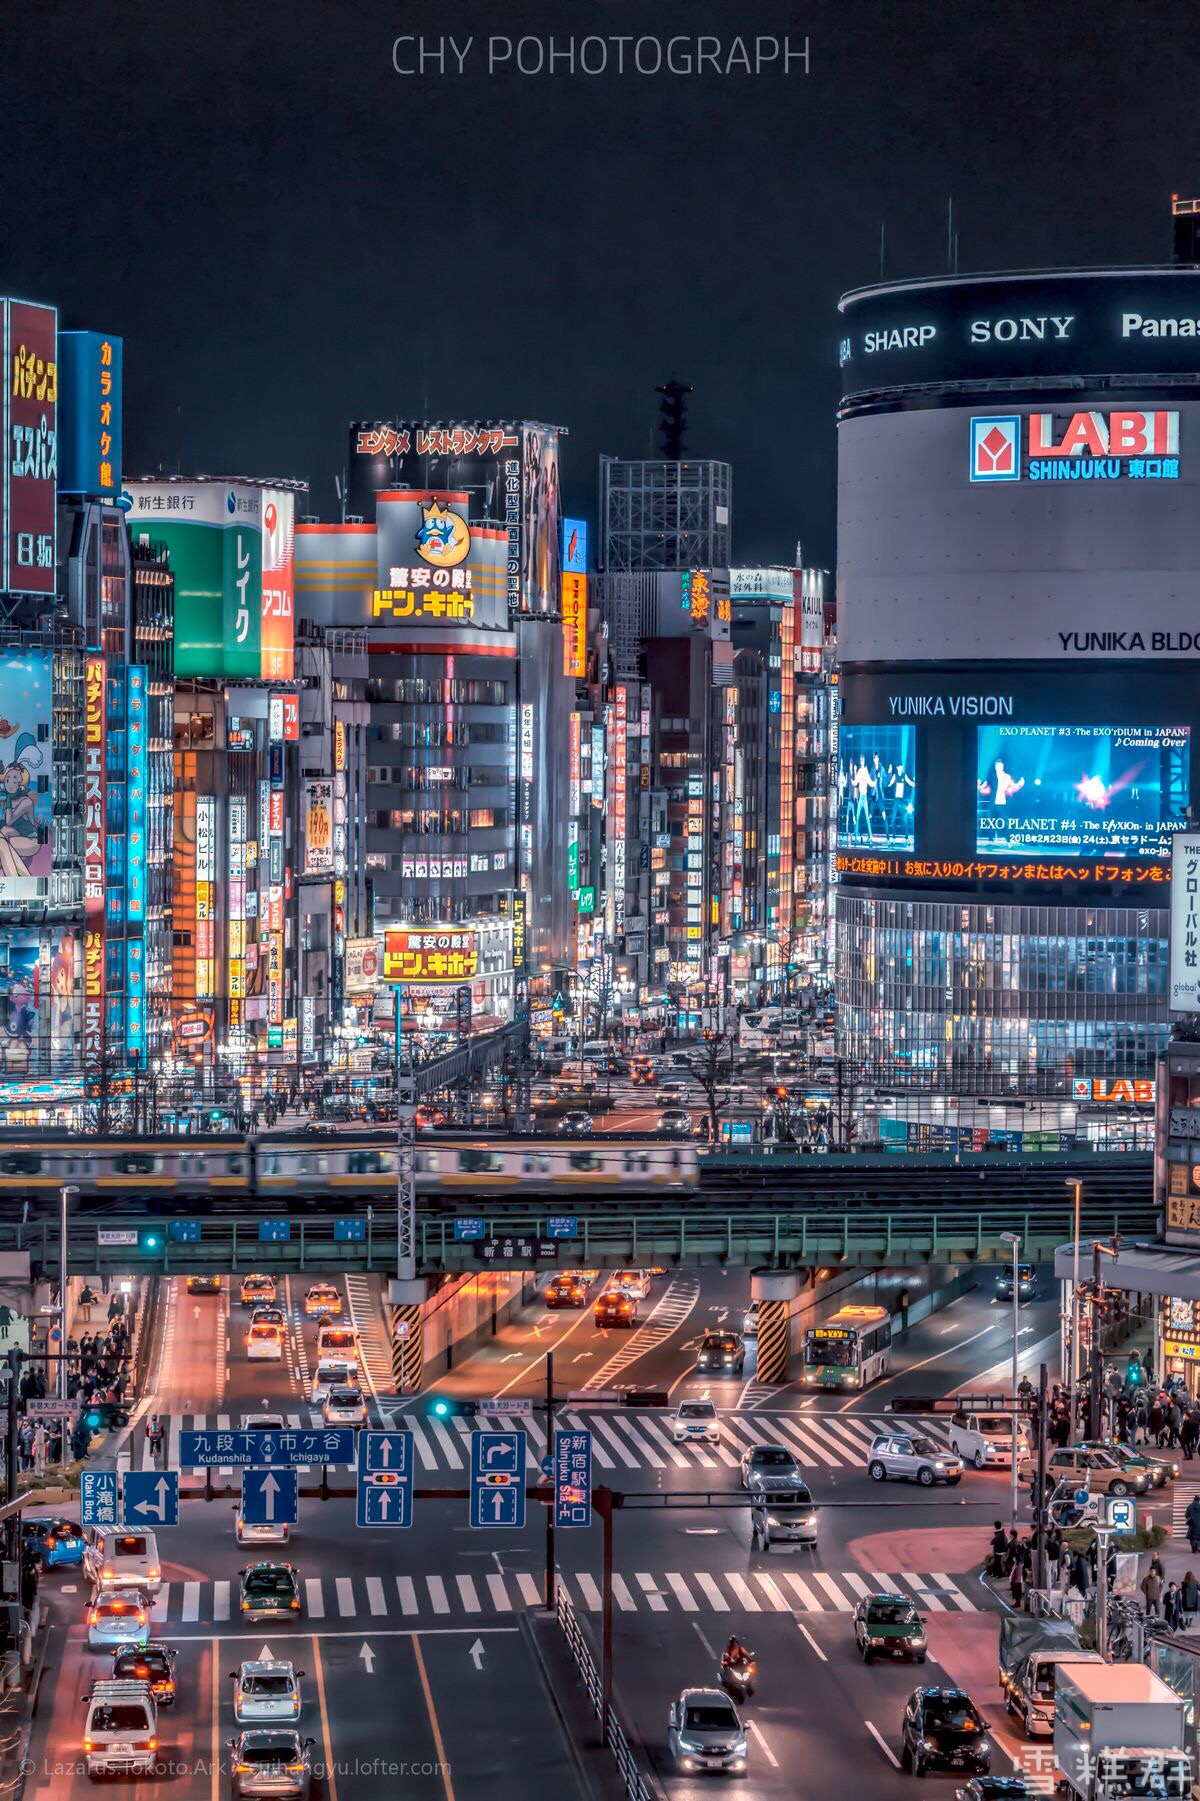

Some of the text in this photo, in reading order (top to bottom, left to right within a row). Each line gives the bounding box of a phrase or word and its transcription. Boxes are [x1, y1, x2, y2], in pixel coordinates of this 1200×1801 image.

[864, 325, 936, 353] SHARP
[970, 316, 1075, 343] SONY
[13, 344, 57, 402] パチンコ
[100, 341, 113, 487] カラオケ館
[12, 413, 57, 480] エスパス
[357, 429, 518, 456] エンタメ レストランタワー
[1028, 410, 1180, 457] LABI
[1029, 459, 1180, 480] SHINJUKU 東口館
[138, 495, 195, 511] 新生銀行
[18, 533, 52, 567] 日拓
[235, 534, 250, 643] レイク
[262, 590, 291, 617] アコム
[802, 596, 822, 616] KAIUL
[1059, 632, 1146, 651] YUNIKA
[86, 664, 102, 742] パチンコ
[889, 696, 1013, 716] YUNIKA VISION
[999, 727, 1018, 736] EXO
[1020, 727, 1056, 736] PLANET
[1058, 728, 1071, 736] #3
[1143, 728, 1153, 736] in
[1122, 737, 1186, 749] Coming Over
[979, 818, 1005, 830] EXO
[1007, 818, 1058, 830] PLANET
[1060, 819, 1076, 830] #4
[1145, 821, 1154, 831] in
[1155, 821, 1188, 832] JAPAN
[198, 810, 208, 869] 小松ビル
[1185, 859, 1199, 968] グローバル社
[408, 934, 470, 949] 驚安の殿堂
[85, 933, 102, 995] パチンコ
[484, 1246, 533, 1258] 新宿駅
[194, 1434, 257, 1452] 九段下
[264, 1443, 272, 1453] 4
[198, 1453, 252, 1463] Kudanshita
[290, 1452, 330, 1463] Ichigaya
[559, 1437, 571, 1482] Shinjuku
[571, 1435, 588, 1522] 新宿駅東口
[84, 1474, 95, 1523] Otaki Brdg.
[96, 1474, 115, 1522] 小滝橋
